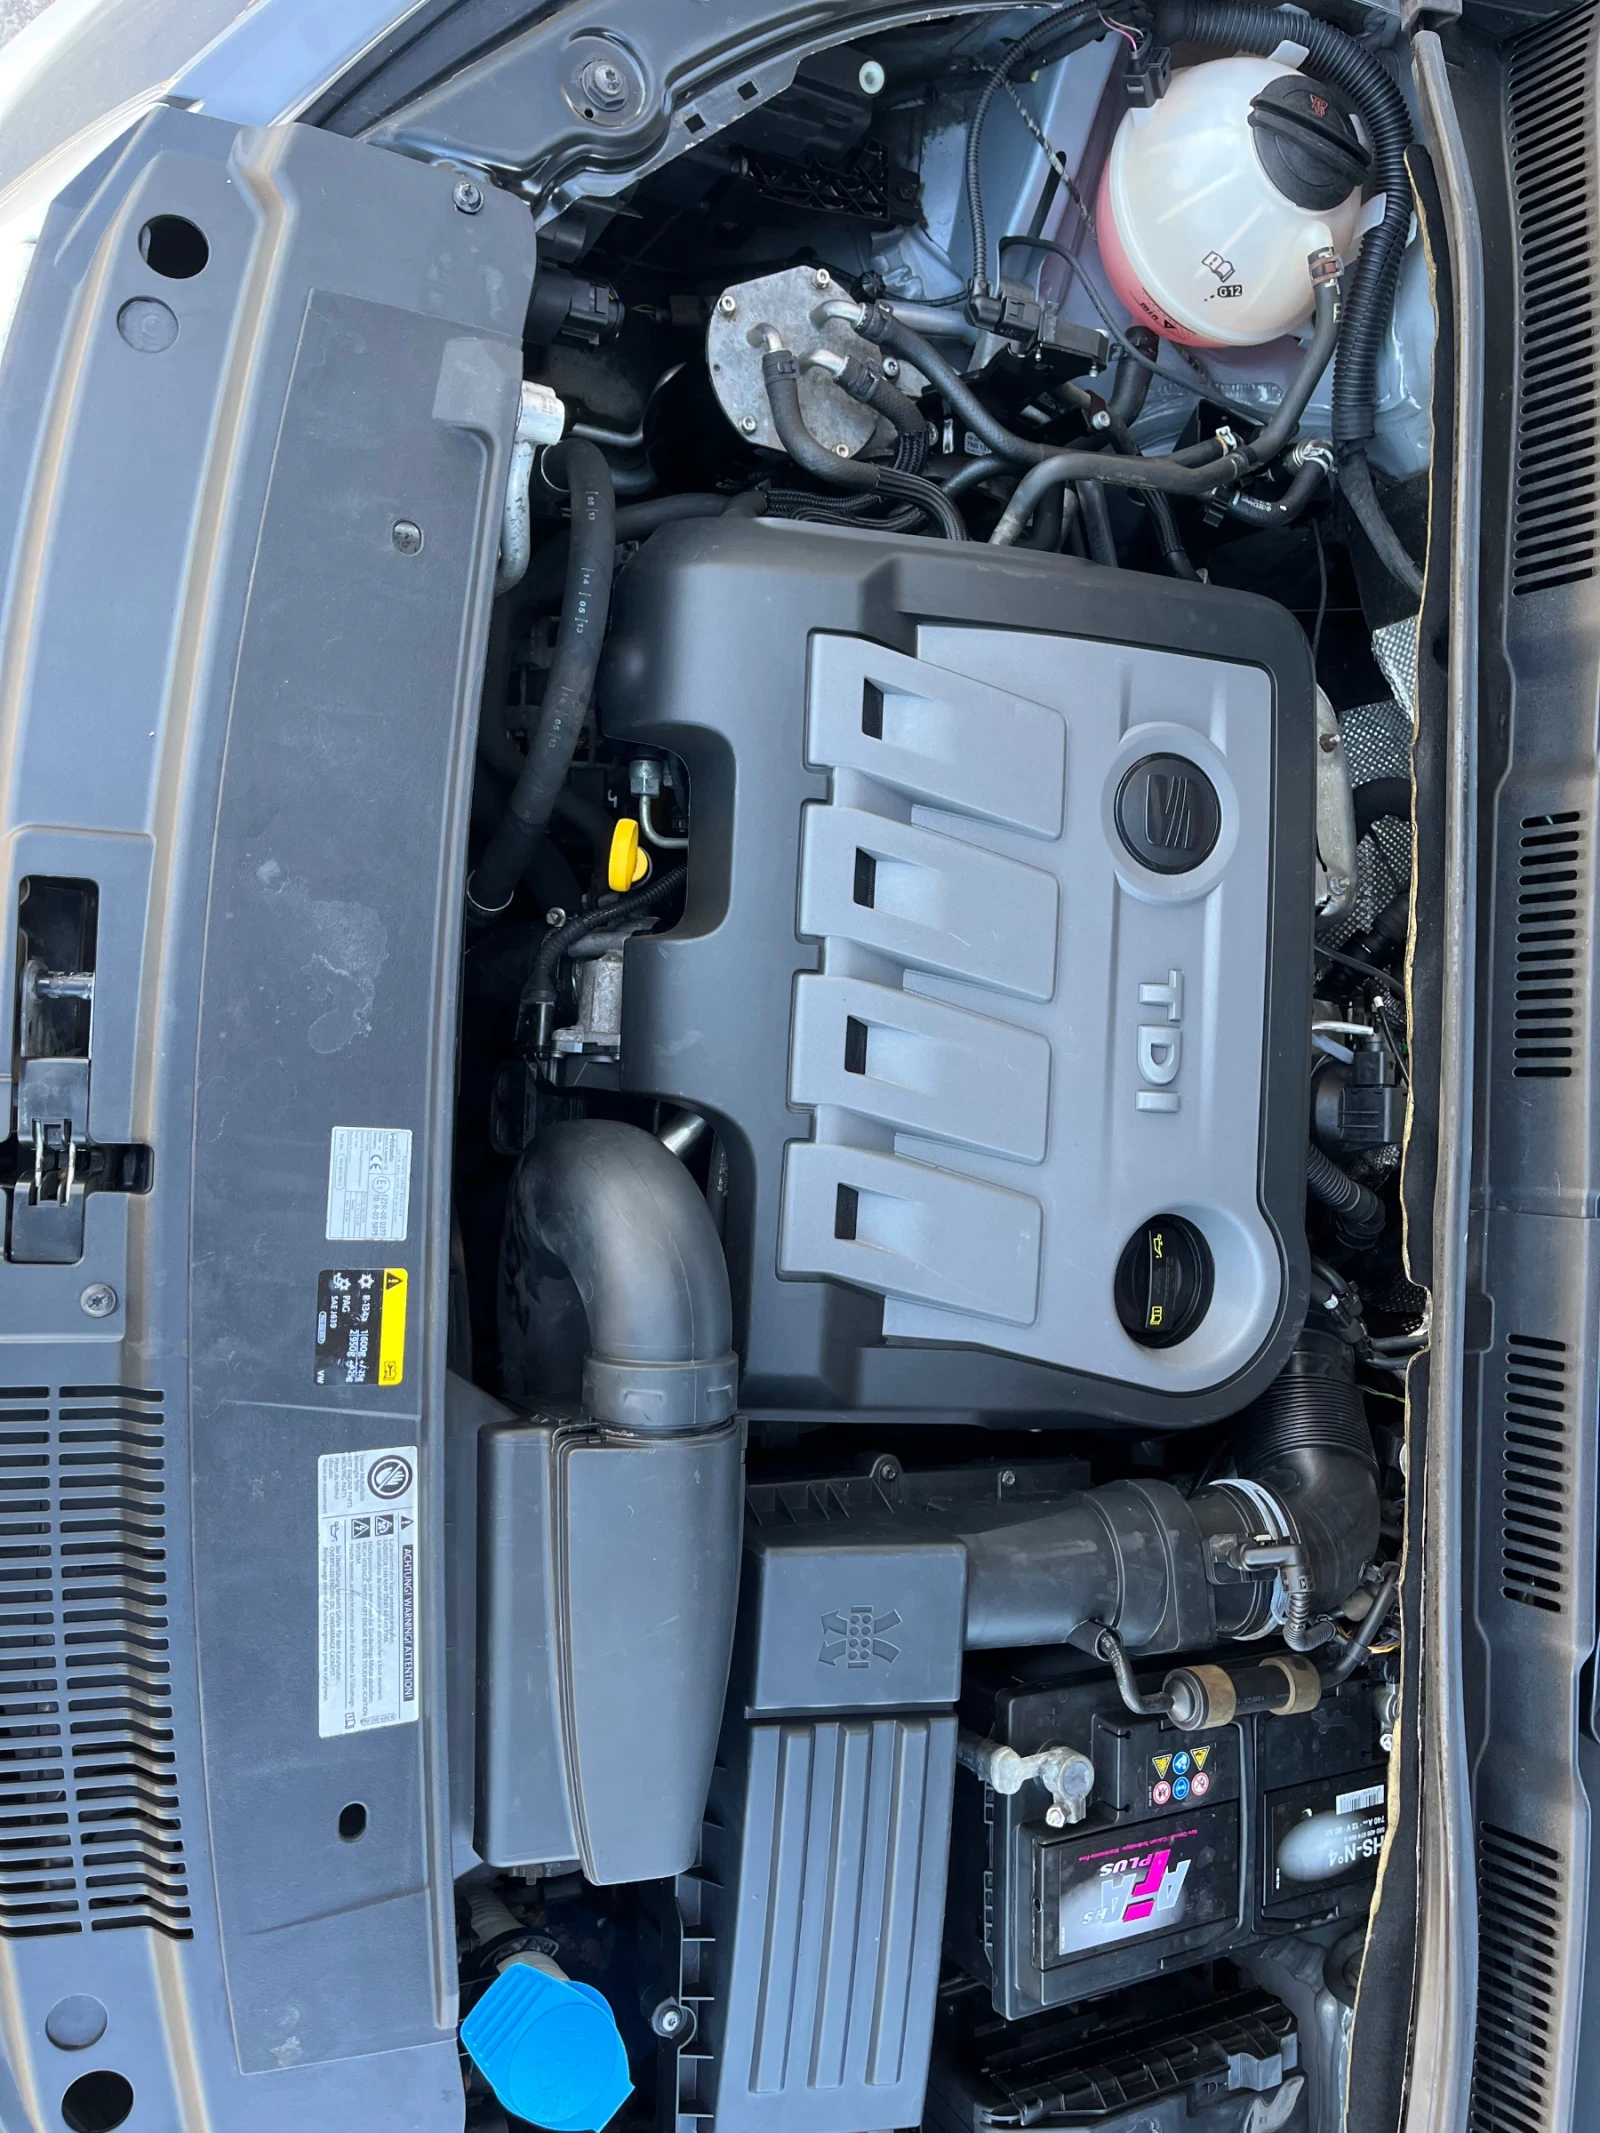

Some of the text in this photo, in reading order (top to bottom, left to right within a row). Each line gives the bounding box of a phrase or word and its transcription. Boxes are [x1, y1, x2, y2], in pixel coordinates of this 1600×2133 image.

[1219, 287, 1242, 297] G12
[1140, 302, 1159, 321] min
[588, 512, 596, 521] 13
[576, 573, 590, 634] 14 05 13
[553, 718, 561, 731] 05
[1136, 967, 1184, 1115] TDI
[370, 1154, 382, 1170] CE
[330, 1295, 339, 1309] SAE
[342, 1295, 351, 1313] PAG
[347, 1336, 357, 1357] 950g
[357, 1336, 368, 1357] 600g
[317, 1370, 325, 1384] VW
[403, 1549, 413, 1698] ACHTUNG! WARNING! ATTENTION!
[1352, 1822, 1359, 1830] 12
[1373, 1815, 1385, 1824] 740
[1099, 1853, 1153, 1877] PLUS
[1082, 1906, 1107, 1925] HS
